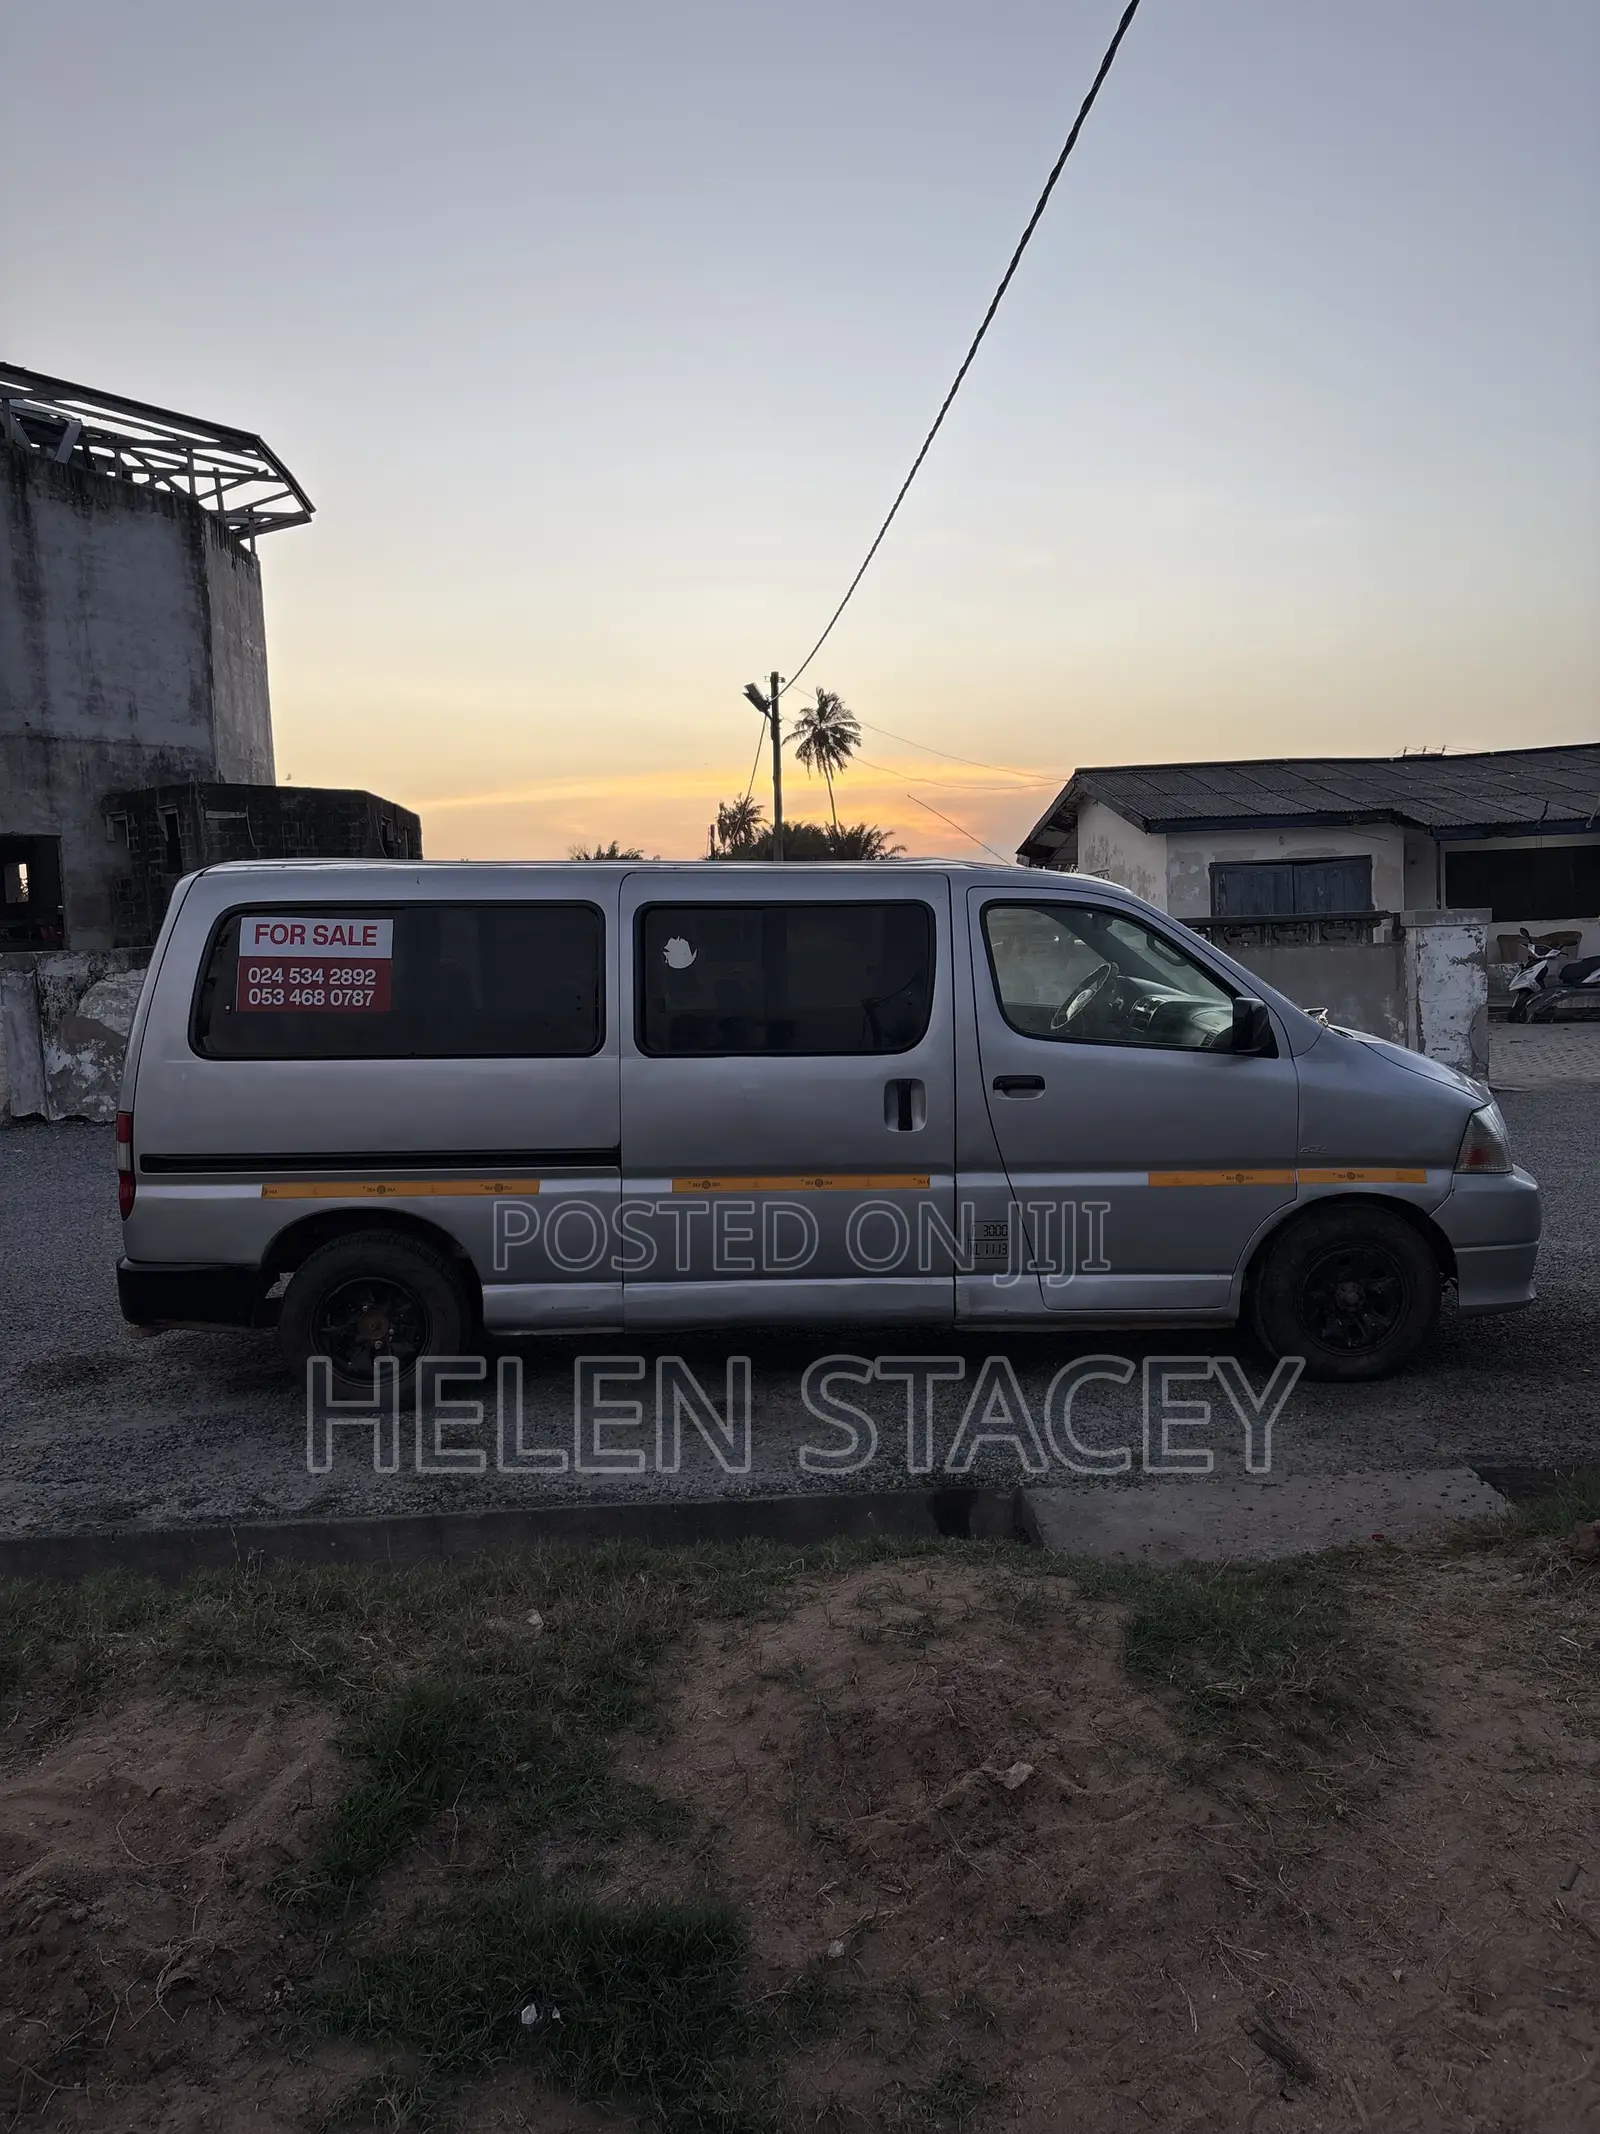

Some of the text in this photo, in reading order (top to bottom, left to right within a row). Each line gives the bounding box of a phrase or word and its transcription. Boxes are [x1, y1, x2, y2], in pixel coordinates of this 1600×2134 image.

[254, 923, 378, 947] FOR SALE
[247, 967, 376, 986] 024 534 2892
[248, 988, 375, 1007] 053 468 0787
[983, 1224, 1008, 1237] 3000
